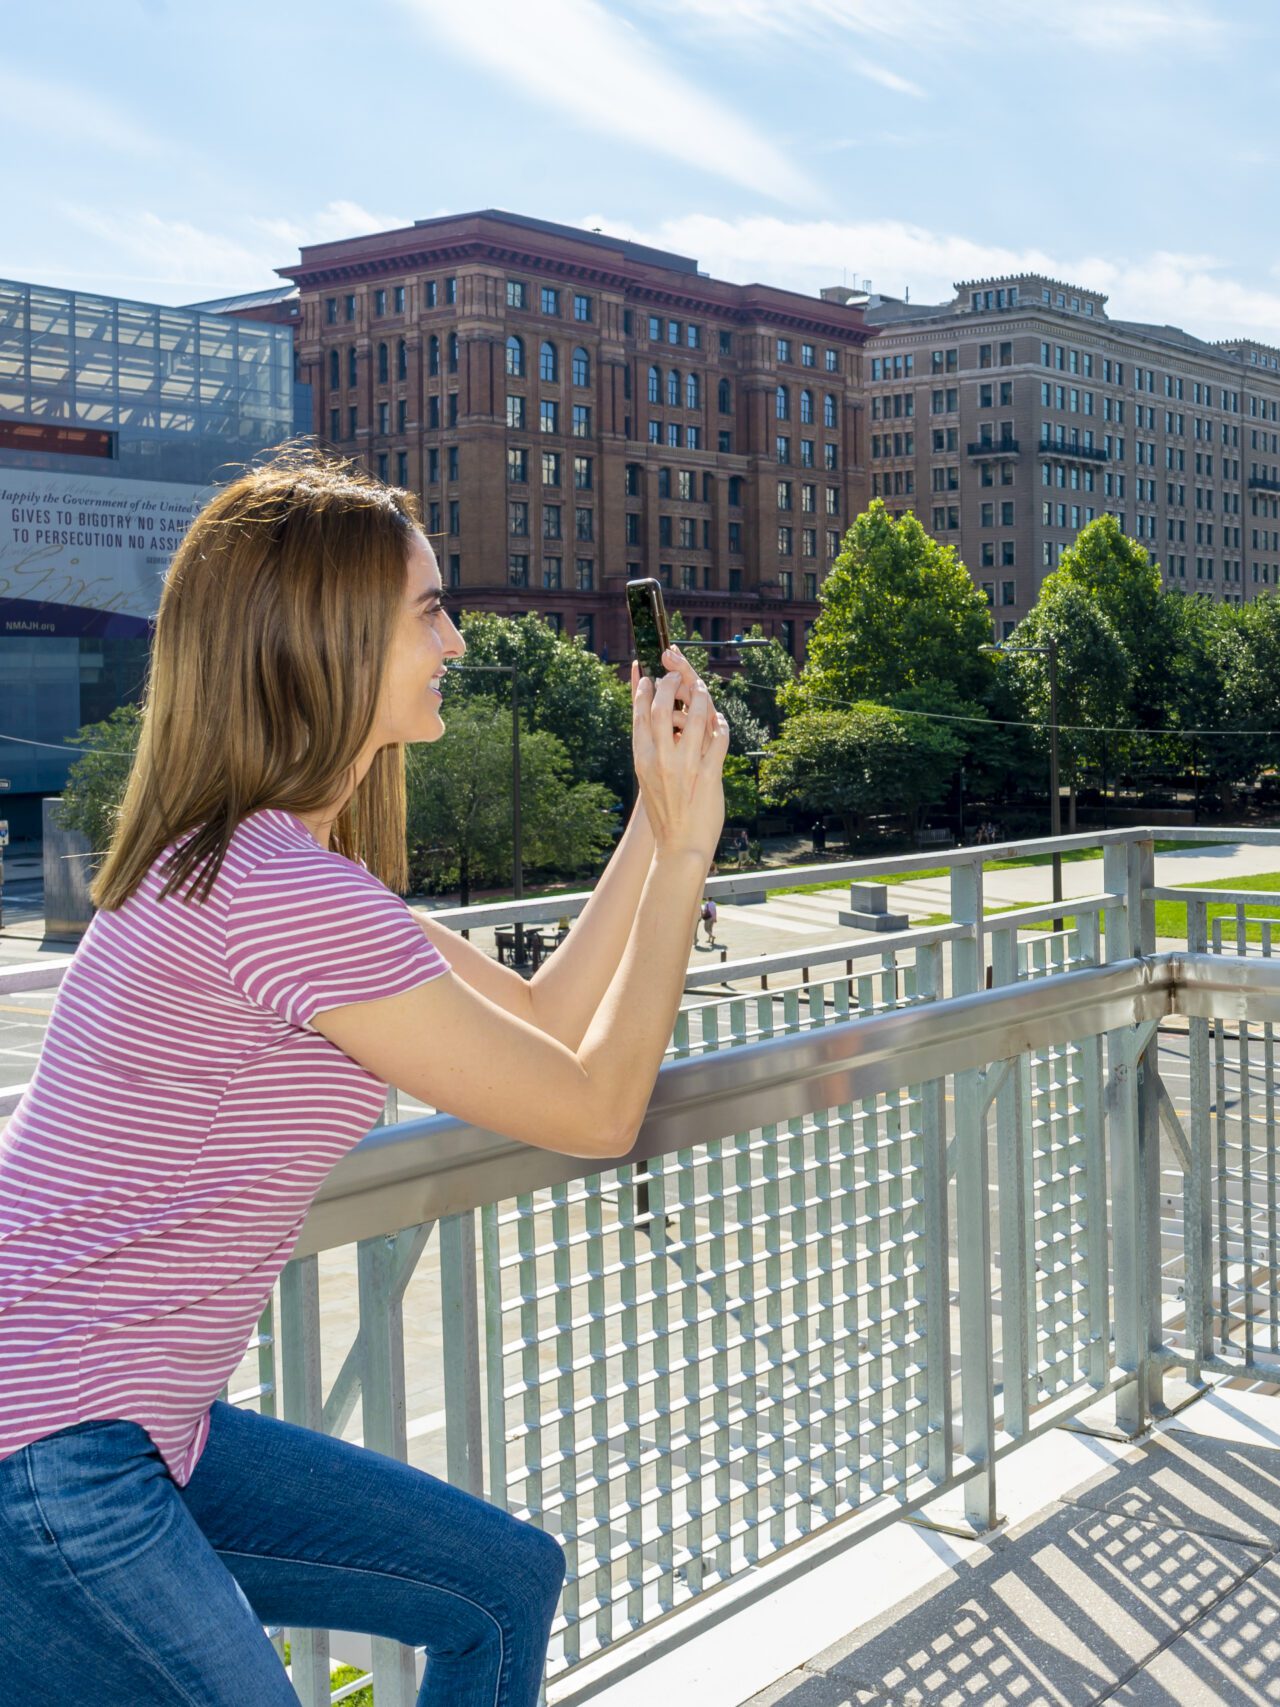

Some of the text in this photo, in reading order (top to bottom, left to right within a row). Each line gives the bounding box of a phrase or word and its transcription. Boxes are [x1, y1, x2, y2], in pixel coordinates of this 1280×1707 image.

[43, 493, 59, 504] the
[62, 493, 127, 508] Government
[130, 500, 141, 512] of
[142, 501, 157, 511] the
[160, 502, 192, 513] United
[12, 508, 50, 524] GIVES
[56, 511, 72, 525] TO
[79, 512, 131, 528] BIGOTRY
[138, 517, 154, 530] NO
[13, 528, 29, 543] TO
[36, 530, 122, 547] PERSECUTION
[128, 534, 145, 549] NO
[6, 621, 55, 632] NMAJH.org
